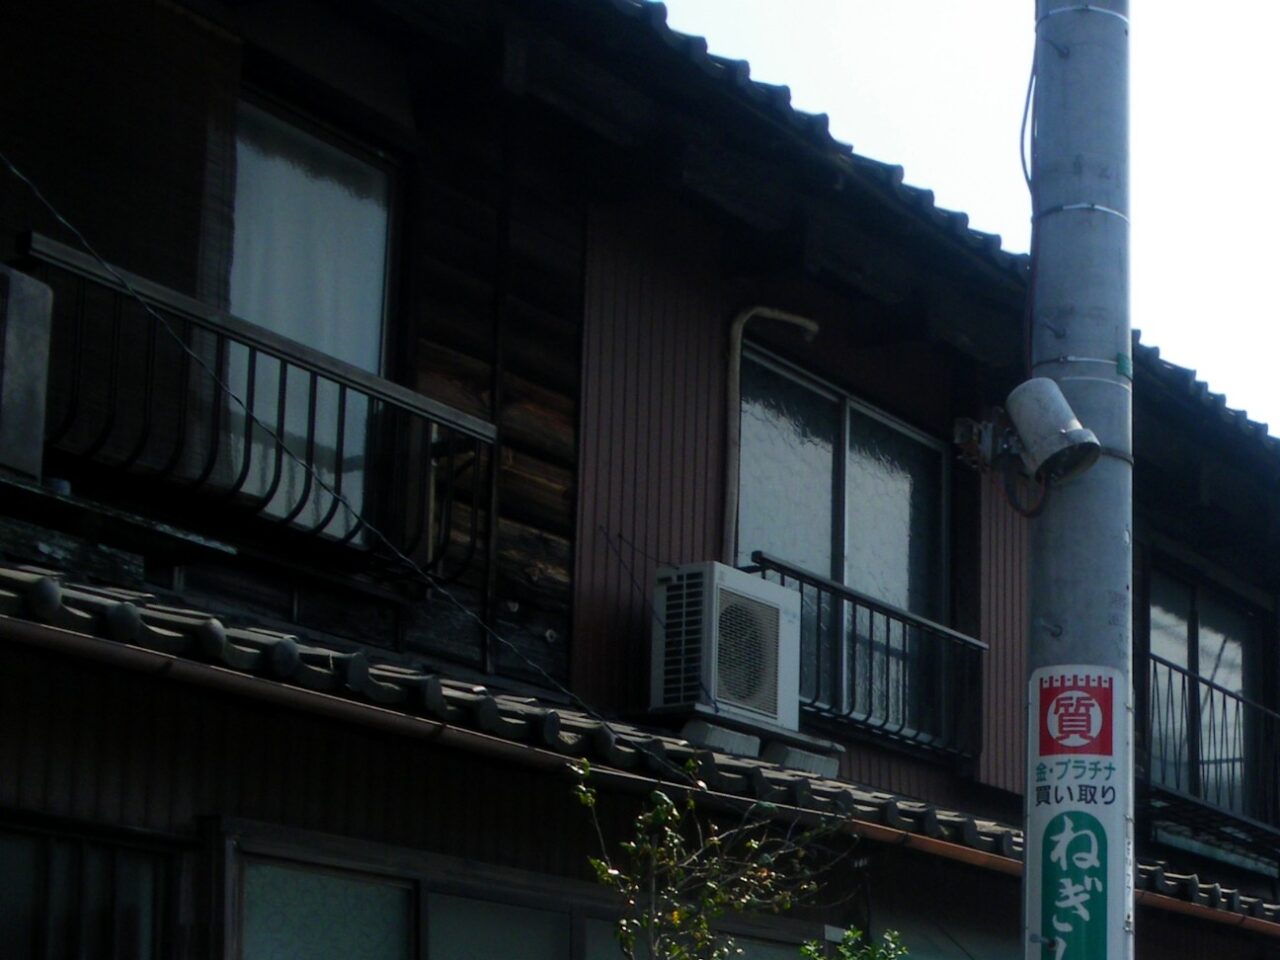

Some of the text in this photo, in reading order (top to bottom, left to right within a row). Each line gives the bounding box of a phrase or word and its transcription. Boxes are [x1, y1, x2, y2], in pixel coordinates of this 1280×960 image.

[1053, 696, 1096, 742] 質
[1035, 784, 1117, 806] 買い取り
